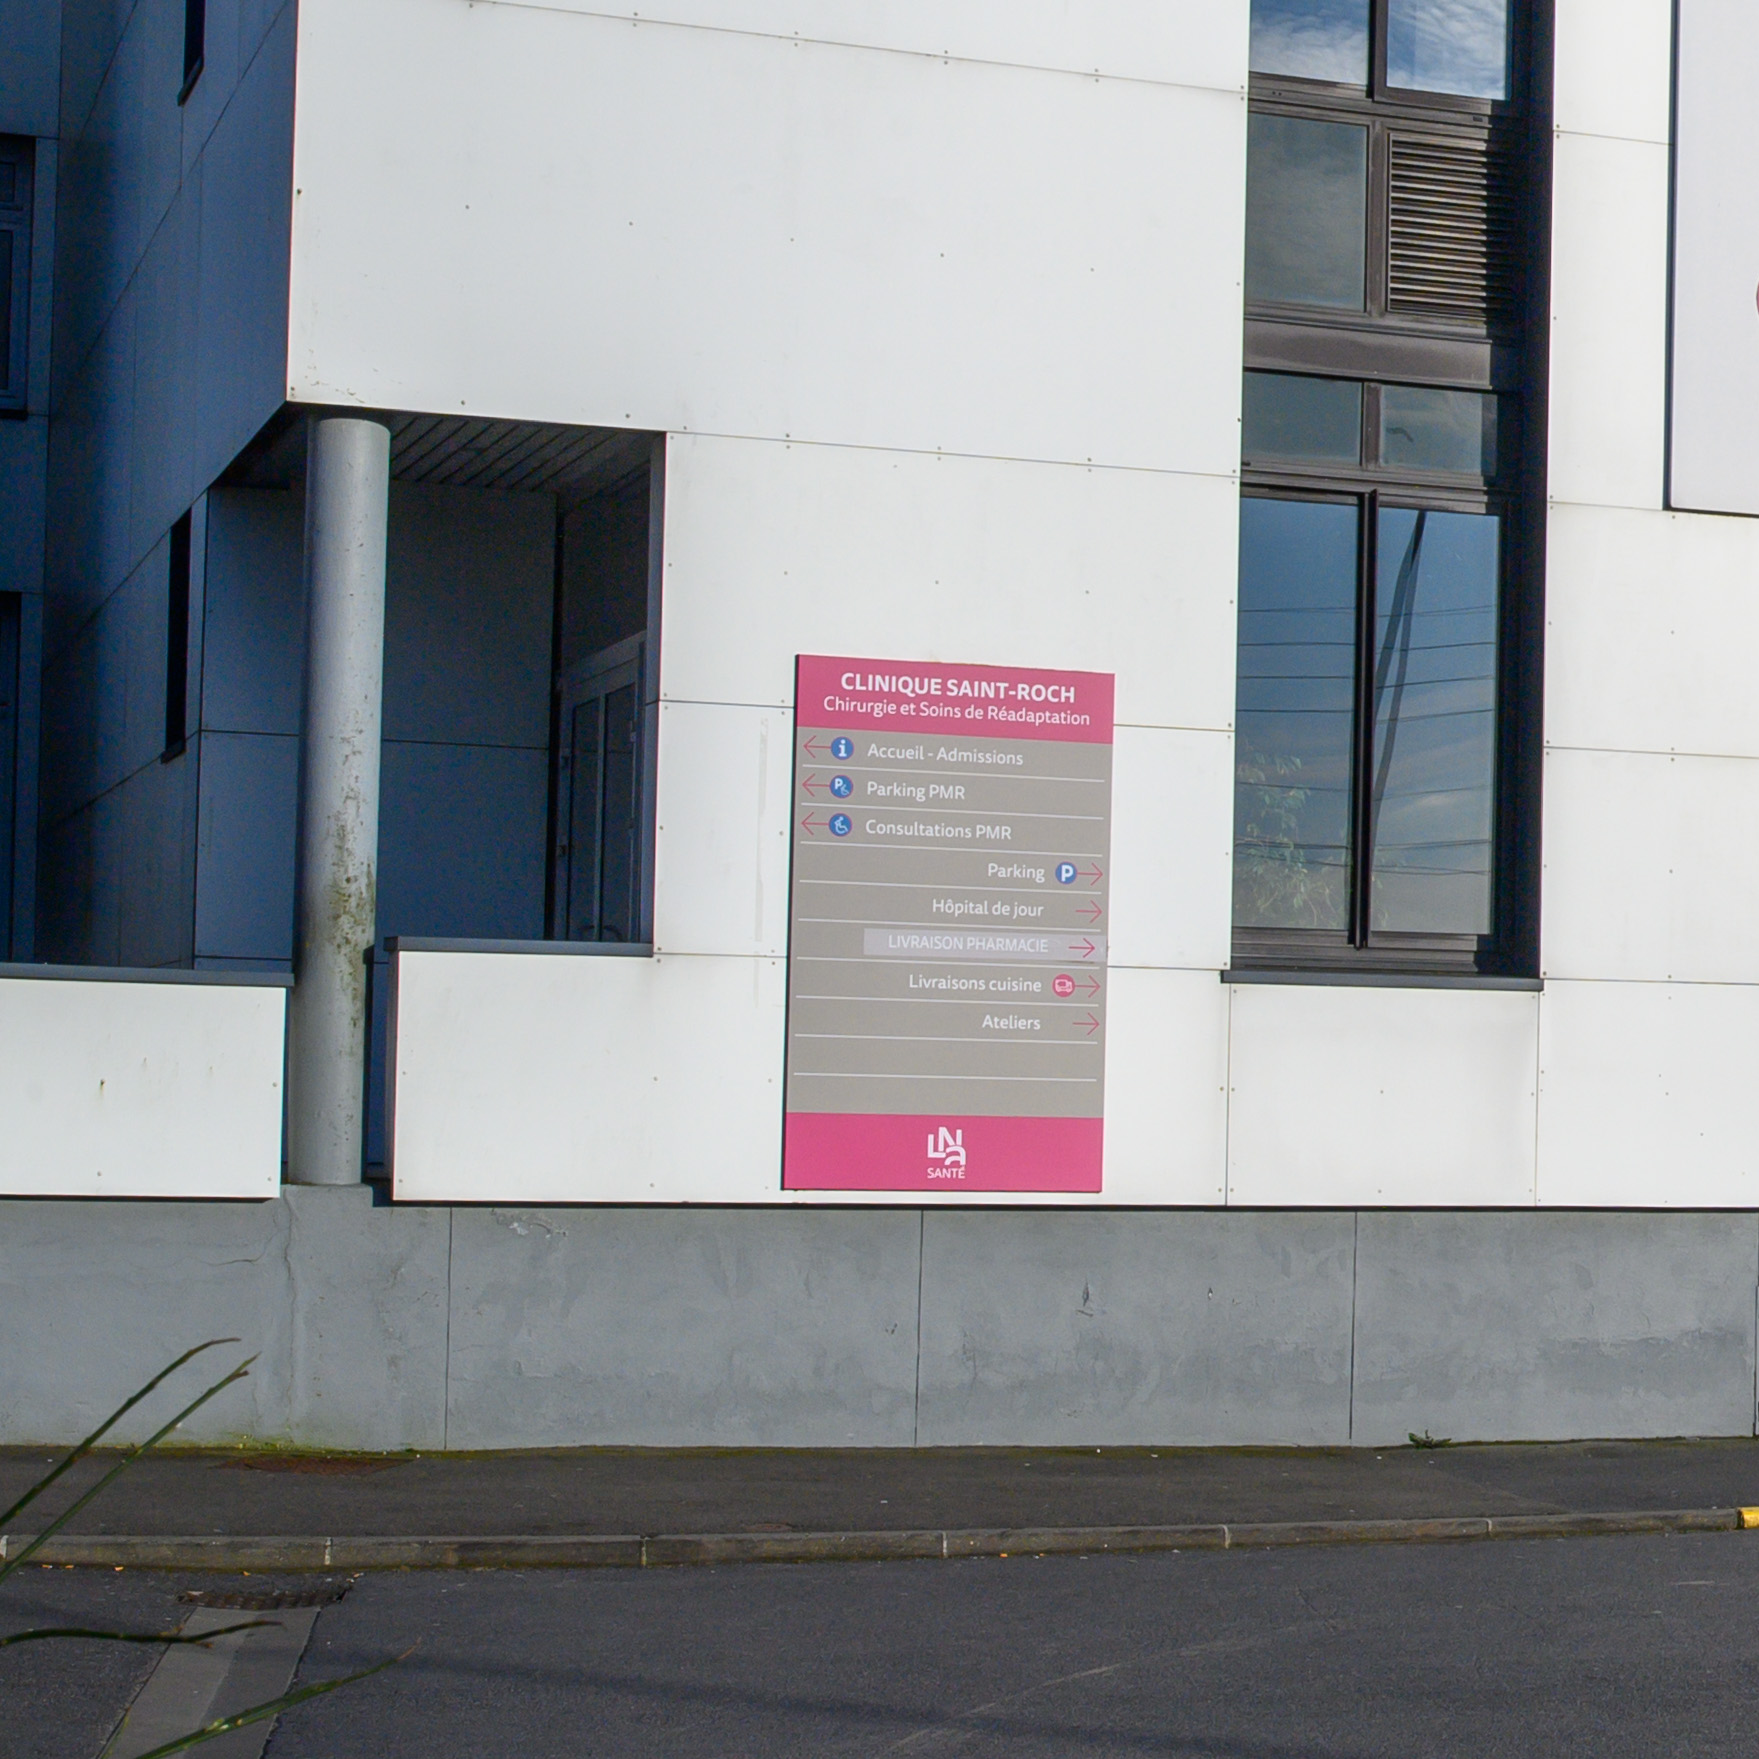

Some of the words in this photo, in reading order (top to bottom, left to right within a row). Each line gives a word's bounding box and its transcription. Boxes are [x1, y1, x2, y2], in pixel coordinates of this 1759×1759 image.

[841, 672, 942, 697] CLINIQUE
[946, 678, 1075, 703] SAINT-ROCH
[823, 695, 897, 717] Chirurgie
[900, 703, 916, 716] et
[919, 701, 961, 718] Soins
[964, 704, 984, 719] de
[987, 705, 1090, 726] Réadaptation
[867, 743, 925, 760] Accueil
[936, 746, 1024, 765] Admissions
[867, 781, 925, 802] Parking
[929, 785, 966, 800] PMR
[865, 819, 972, 838] Consultations
[976, 825, 1012, 840] PMR
[988, 863, 1045, 883] Parking
[932, 898, 989, 916] Hôpital
[992, 901, 1011, 916] de
[1012, 902, 1045, 920] jour
[888, 935, 964, 951] LIVRAISON
[966, 937, 1049, 953] PHARMACIE
[909, 974, 986, 991] Livraisons
[989, 979, 1042, 992] cuisine
[982, 1014, 1041, 1030] Ateliers
[927, 1166, 966, 1179] SANTÉ
